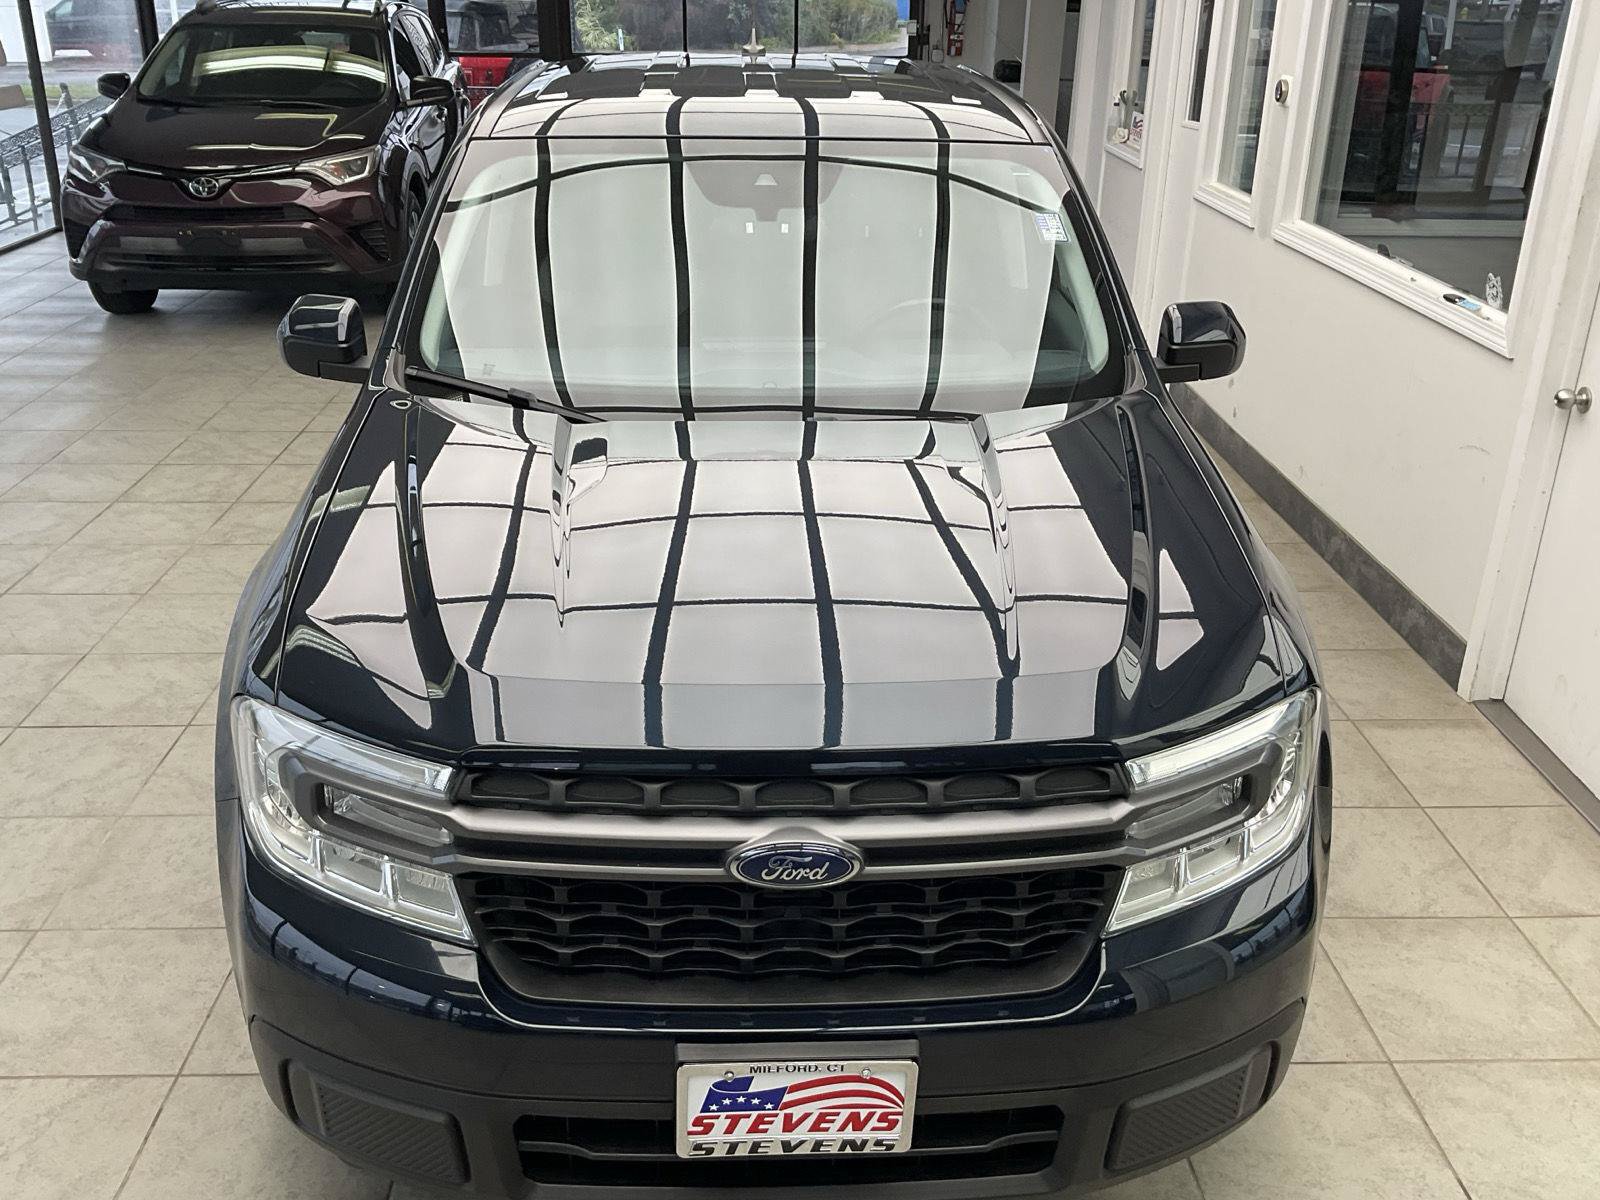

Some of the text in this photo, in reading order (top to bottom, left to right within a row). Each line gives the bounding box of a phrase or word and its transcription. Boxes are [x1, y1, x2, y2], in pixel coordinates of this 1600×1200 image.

[761, 855, 830, 881] Ford
[687, 1111, 903, 1136] STEVENS
[689, 1138, 897, 1157] STEVENS
